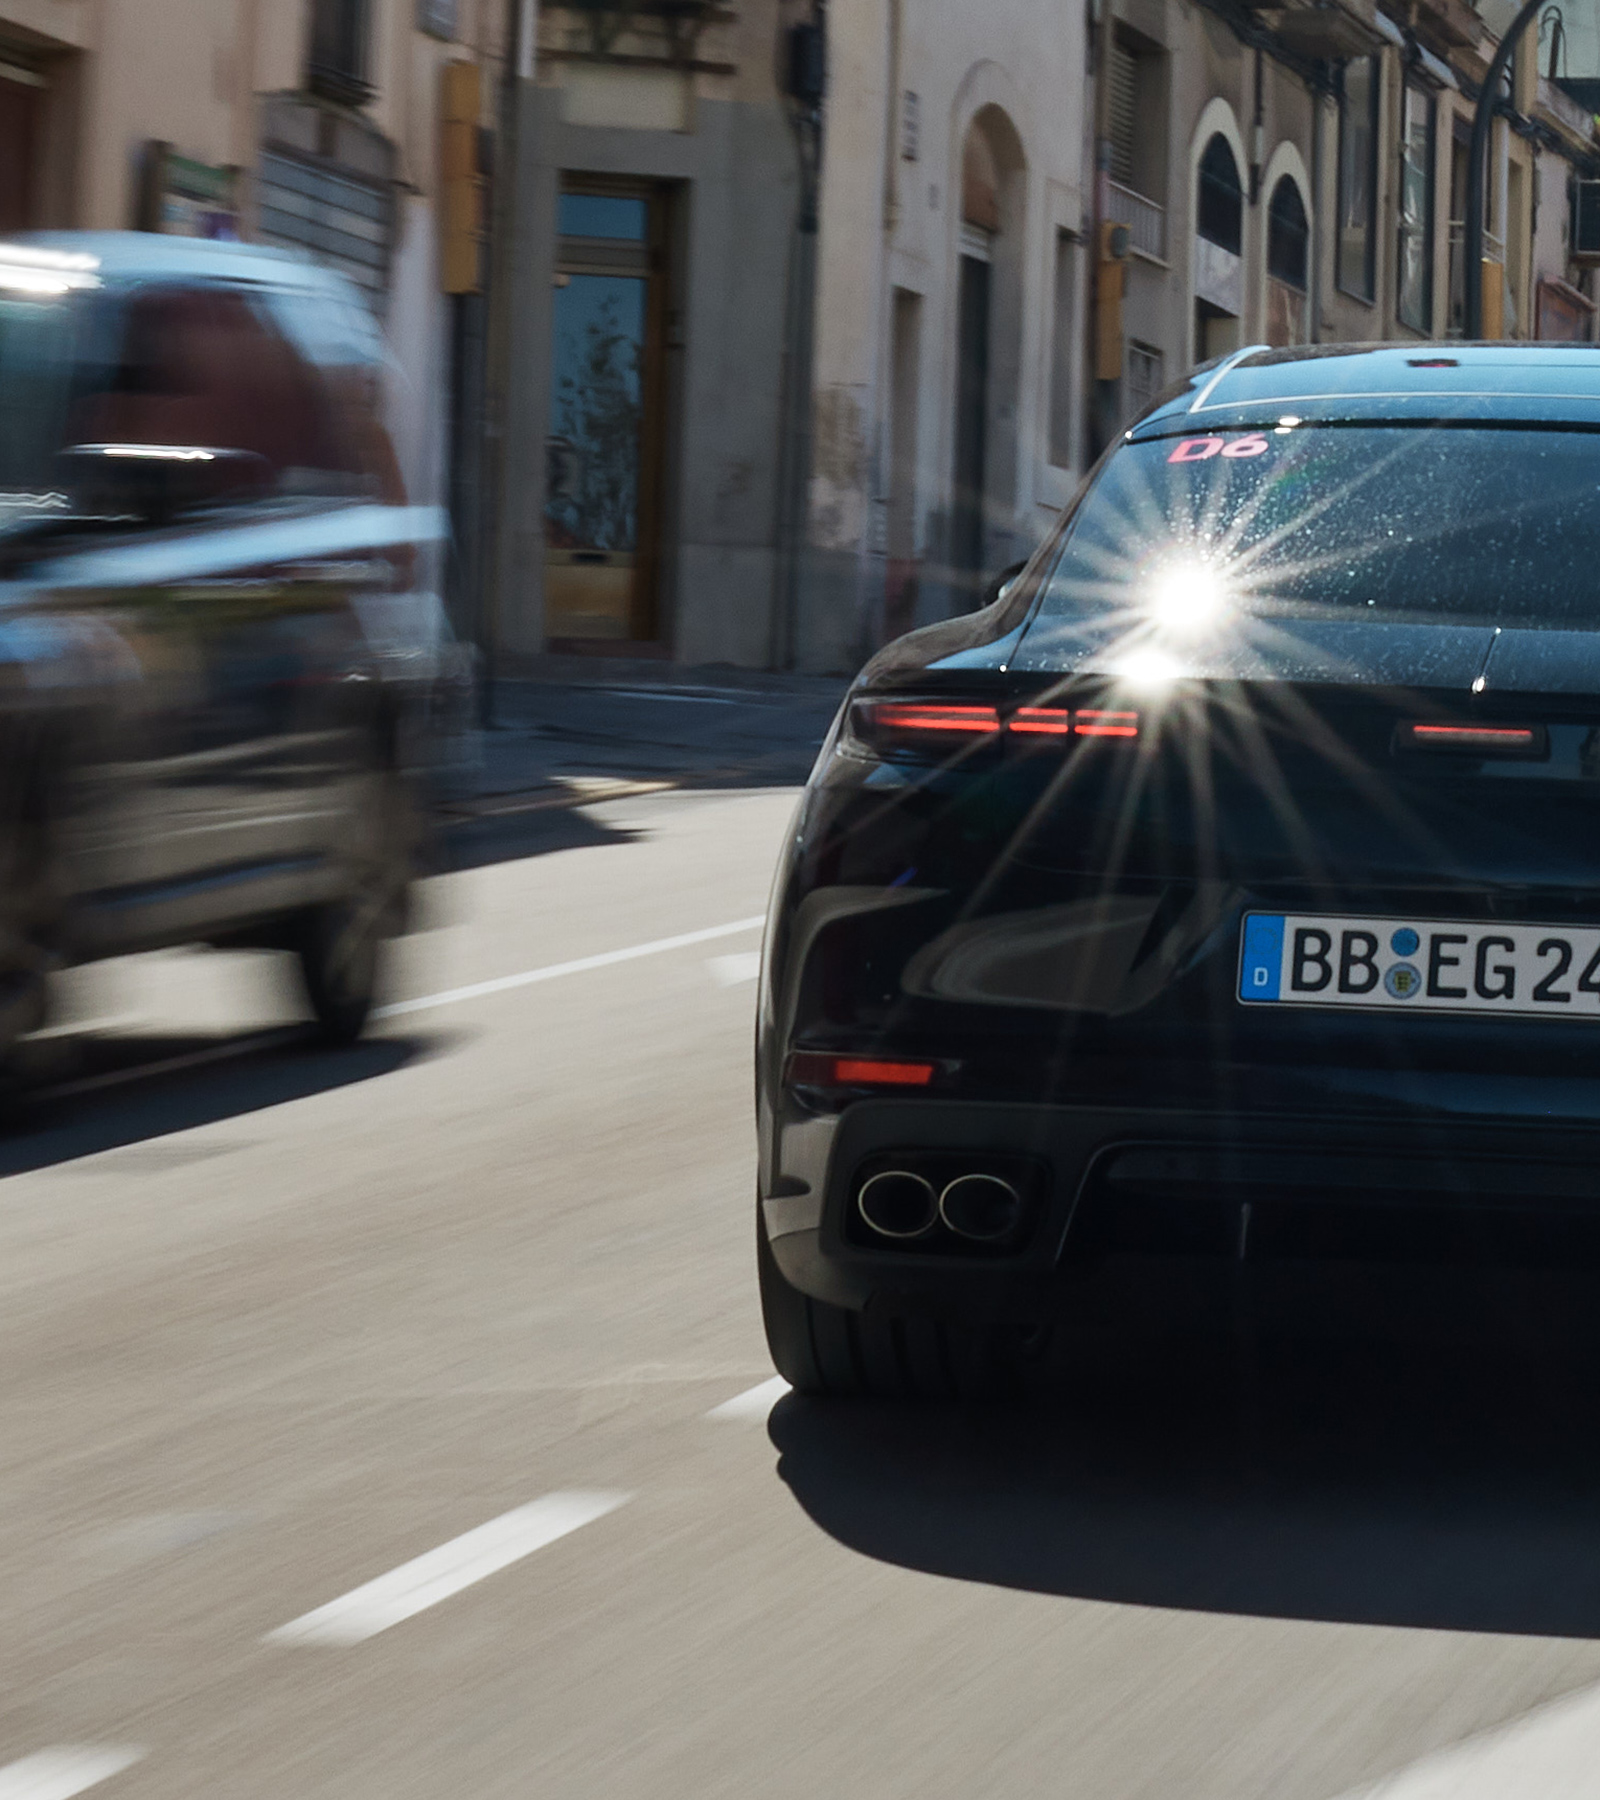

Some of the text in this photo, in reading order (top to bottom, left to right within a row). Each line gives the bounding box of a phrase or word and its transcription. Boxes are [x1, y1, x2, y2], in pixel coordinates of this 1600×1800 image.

[1167, 433, 1269, 463] D6
[1253, 966, 1269, 987] D
[1291, 927, 1380, 994] BB
[1426, 933, 1516, 999] EG
